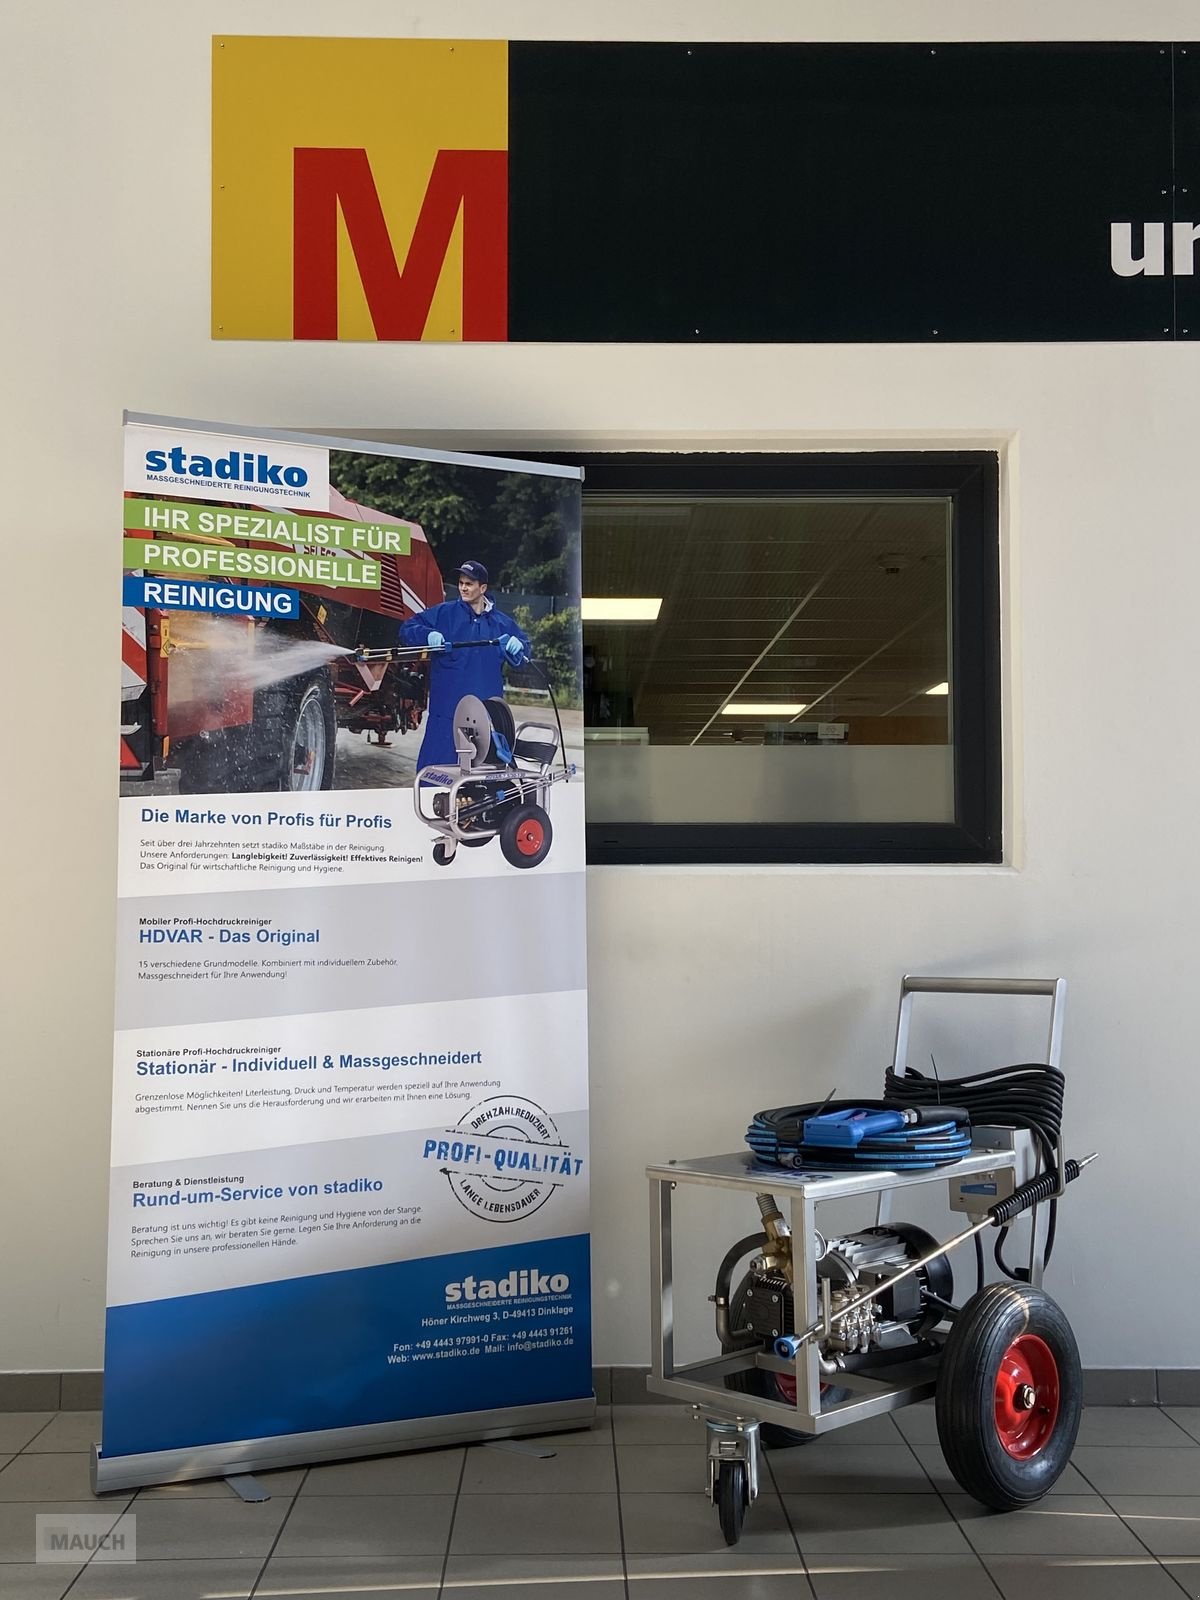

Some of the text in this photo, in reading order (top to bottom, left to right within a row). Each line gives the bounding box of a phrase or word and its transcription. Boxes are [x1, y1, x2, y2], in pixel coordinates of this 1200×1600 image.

[293, 147, 508, 342] M
[145, 446, 308, 488] stadiko
[146, 474, 311, 498] MASSGESCHNEIDERTE REINIGUNGSTECHNIK
[144, 507, 190, 531] IHR
[198, 512, 345, 545] SPEZIALIST
[352, 526, 402, 551] FÜR
[144, 544, 377, 584] PROFESSIONELLE
[144, 582, 292, 613] REINIGUNG
[424, 771, 453, 785] stadiko
[141, 809, 392, 829] Die Marke von Profis für Profis
[140, 839, 156, 848] Seit
[157, 839, 175, 848] über
[177, 840, 192, 848] drei
[195, 840, 240, 849] Jahrzehnten
[242, 841, 259, 849] setzt
[262, 841, 288, 850] stadiko
[290, 842, 325, 851] Maßstäbe
[326, 842, 333, 850] in
[335, 842, 347, 851] der
[140, 851, 167, 859] Unsere
[232, 852, 288, 862] Langlebigkeit!
[290, 853, 348, 863] Zuverlässigkeit!
[350, 854, 387, 863] Effektives
[389, 855, 423, 864] Reinigen!
[140, 862, 344, 873] Das Original für wirtschaftliche Reinigung und Hygiene.
[139, 917, 272, 927] Mobiler Profi-Hochdruckreiniger
[139, 929, 203, 943] HDVAR
[219, 929, 251, 943] Das
[256, 929, 320, 946] Original
[139, 960, 148, 968] 15
[150, 959, 202, 968] verschiedene
[261, 959, 302, 967] Kombiniert
[303, 959, 315, 967] mit
[317, 959, 365, 967] individuellem
[138, 970, 287, 981] Massgeschneidert für Ihre Anwendung!
[136, 1046, 281, 1058] Stationäre Profi-Hochdruckreiniger
[136, 1060, 216, 1076] Stationär
[232, 1056, 317, 1072] Individuell
[323, 1055, 334, 1069] &
[340, 1051, 482, 1070] Massgeschneidert
[135, 1093, 184, 1101] Grenzenlose
[186, 1089, 243, 1100] Möglichkeiten!
[294, 1086, 315, 1095] Druck
[334, 1085, 374, 1094] Temperatur
[377, 1083, 403, 1091] werden
[404, 1081, 430, 1090] speziell
[432, 1081, 443, 1089] auf
[444, 1080, 458, 1088] Ihre
[460, 1079, 501, 1088] Anwendung
[187, 1103, 217, 1111] Nennen
[249, 1100, 260, 1108] die
[263, 1098, 324, 1108] Herausforderung
[326, 1096, 340, 1104] und
[342, 1096, 354, 1104] wir
[355, 1094, 392, 1103] erarbeiten
[393, 1093, 405, 1101] mit
[407, 1092, 426, 1101] Ihnen
[428, 1092, 443, 1100] eine
[471, 1107, 550, 1140] DREHZAHLREDUZIERT
[133, 1180, 173, 1189] Beratung
[184, 1176, 244, 1186] Dienstleistung
[133, 1178, 383, 1207] Rund-um-Service von stadiko
[459, 1179, 541, 1213] LANGE LEBENSDAUER
[131, 1235, 168, 1246] Sprechen
[171, 1234, 183, 1243] Sie
[185, 1234, 199, 1242] uns
[214, 1231, 226, 1239] wir
[228, 1228, 258, 1238] beraten
[260, 1227, 271, 1236] Sie
[298, 1224, 321, 1235] Legen
[323, 1222, 334, 1231] Sie
[336, 1221, 350, 1230] Ihre
[352, 1218, 398, 1230] Anforderung
[400, 1217, 409, 1226] an
[410, 1216, 421, 1225] die
[132, 1224, 168, 1235] Beratung
[170, 1223, 180, 1231] ist
[182, 1222, 196, 1231] uns
[198, 1218, 228, 1230] wichtig!
[241, 1217, 256, 1227] gibt
[259, 1216, 279, 1225] keine
[281, 1212, 318, 1224] Reinigung
[319, 1211, 334, 1219] und
[336, 1208, 366, 1220] Hygiene
[368, 1208, 381, 1216] von
[384, 1206, 395, 1215] der
[131, 1247, 172, 1259] Reinigung
[174, 1246, 181, 1255] in
[183, 1245, 210, 1254] unsere
[212, 1240, 270, 1253] professionellen
[445, 1269, 569, 1302] stadiko
[447, 1294, 572, 1310] MASSGESCHNEIDERTE REINIGUNGSTECHNIK
[421, 1317, 448, 1327] Höner
[450, 1313, 490, 1324] Kirchweg
[503, 1308, 536, 1319] D-49413
[538, 1305, 574, 1316] Dinklage
[393, 1326, 573, 1352] Fon: +49 4443 97991-0 Fax: +49 4443 91261
[388, 1337, 574, 1364] Web: www.stadiko.de Mail: info@stadiko.de
